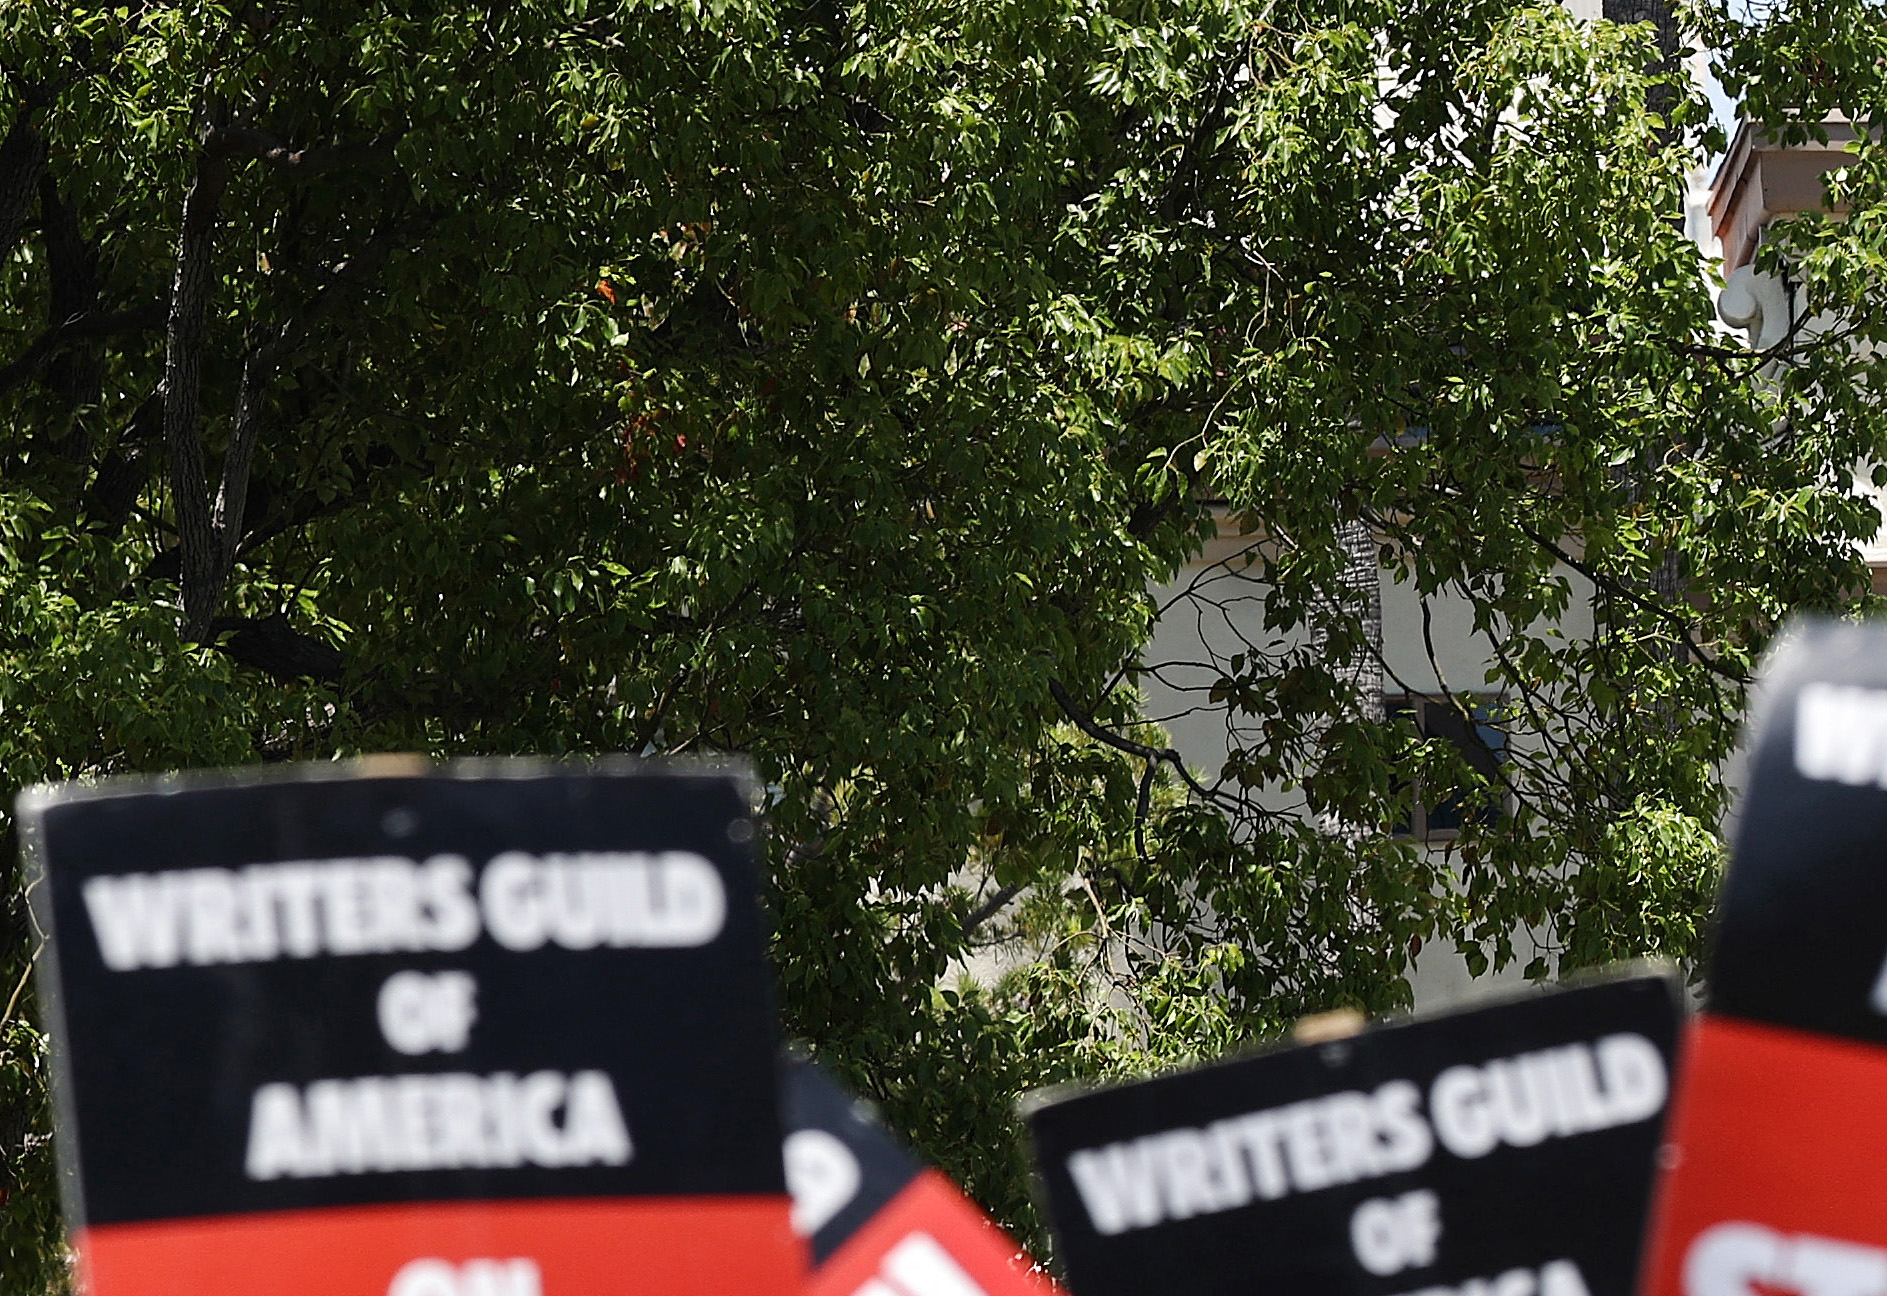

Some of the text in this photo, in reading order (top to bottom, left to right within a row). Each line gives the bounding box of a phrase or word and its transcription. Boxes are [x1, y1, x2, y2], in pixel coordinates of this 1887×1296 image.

[88, 854, 723, 968] WRITERS GUILD
[381, 973, 475, 1052] OF
[248, 1074, 629, 1178] AMERICA
[1070, 1035, 1666, 1234] WRITERS GUILD
[1353, 1194, 1437, 1272] OF
